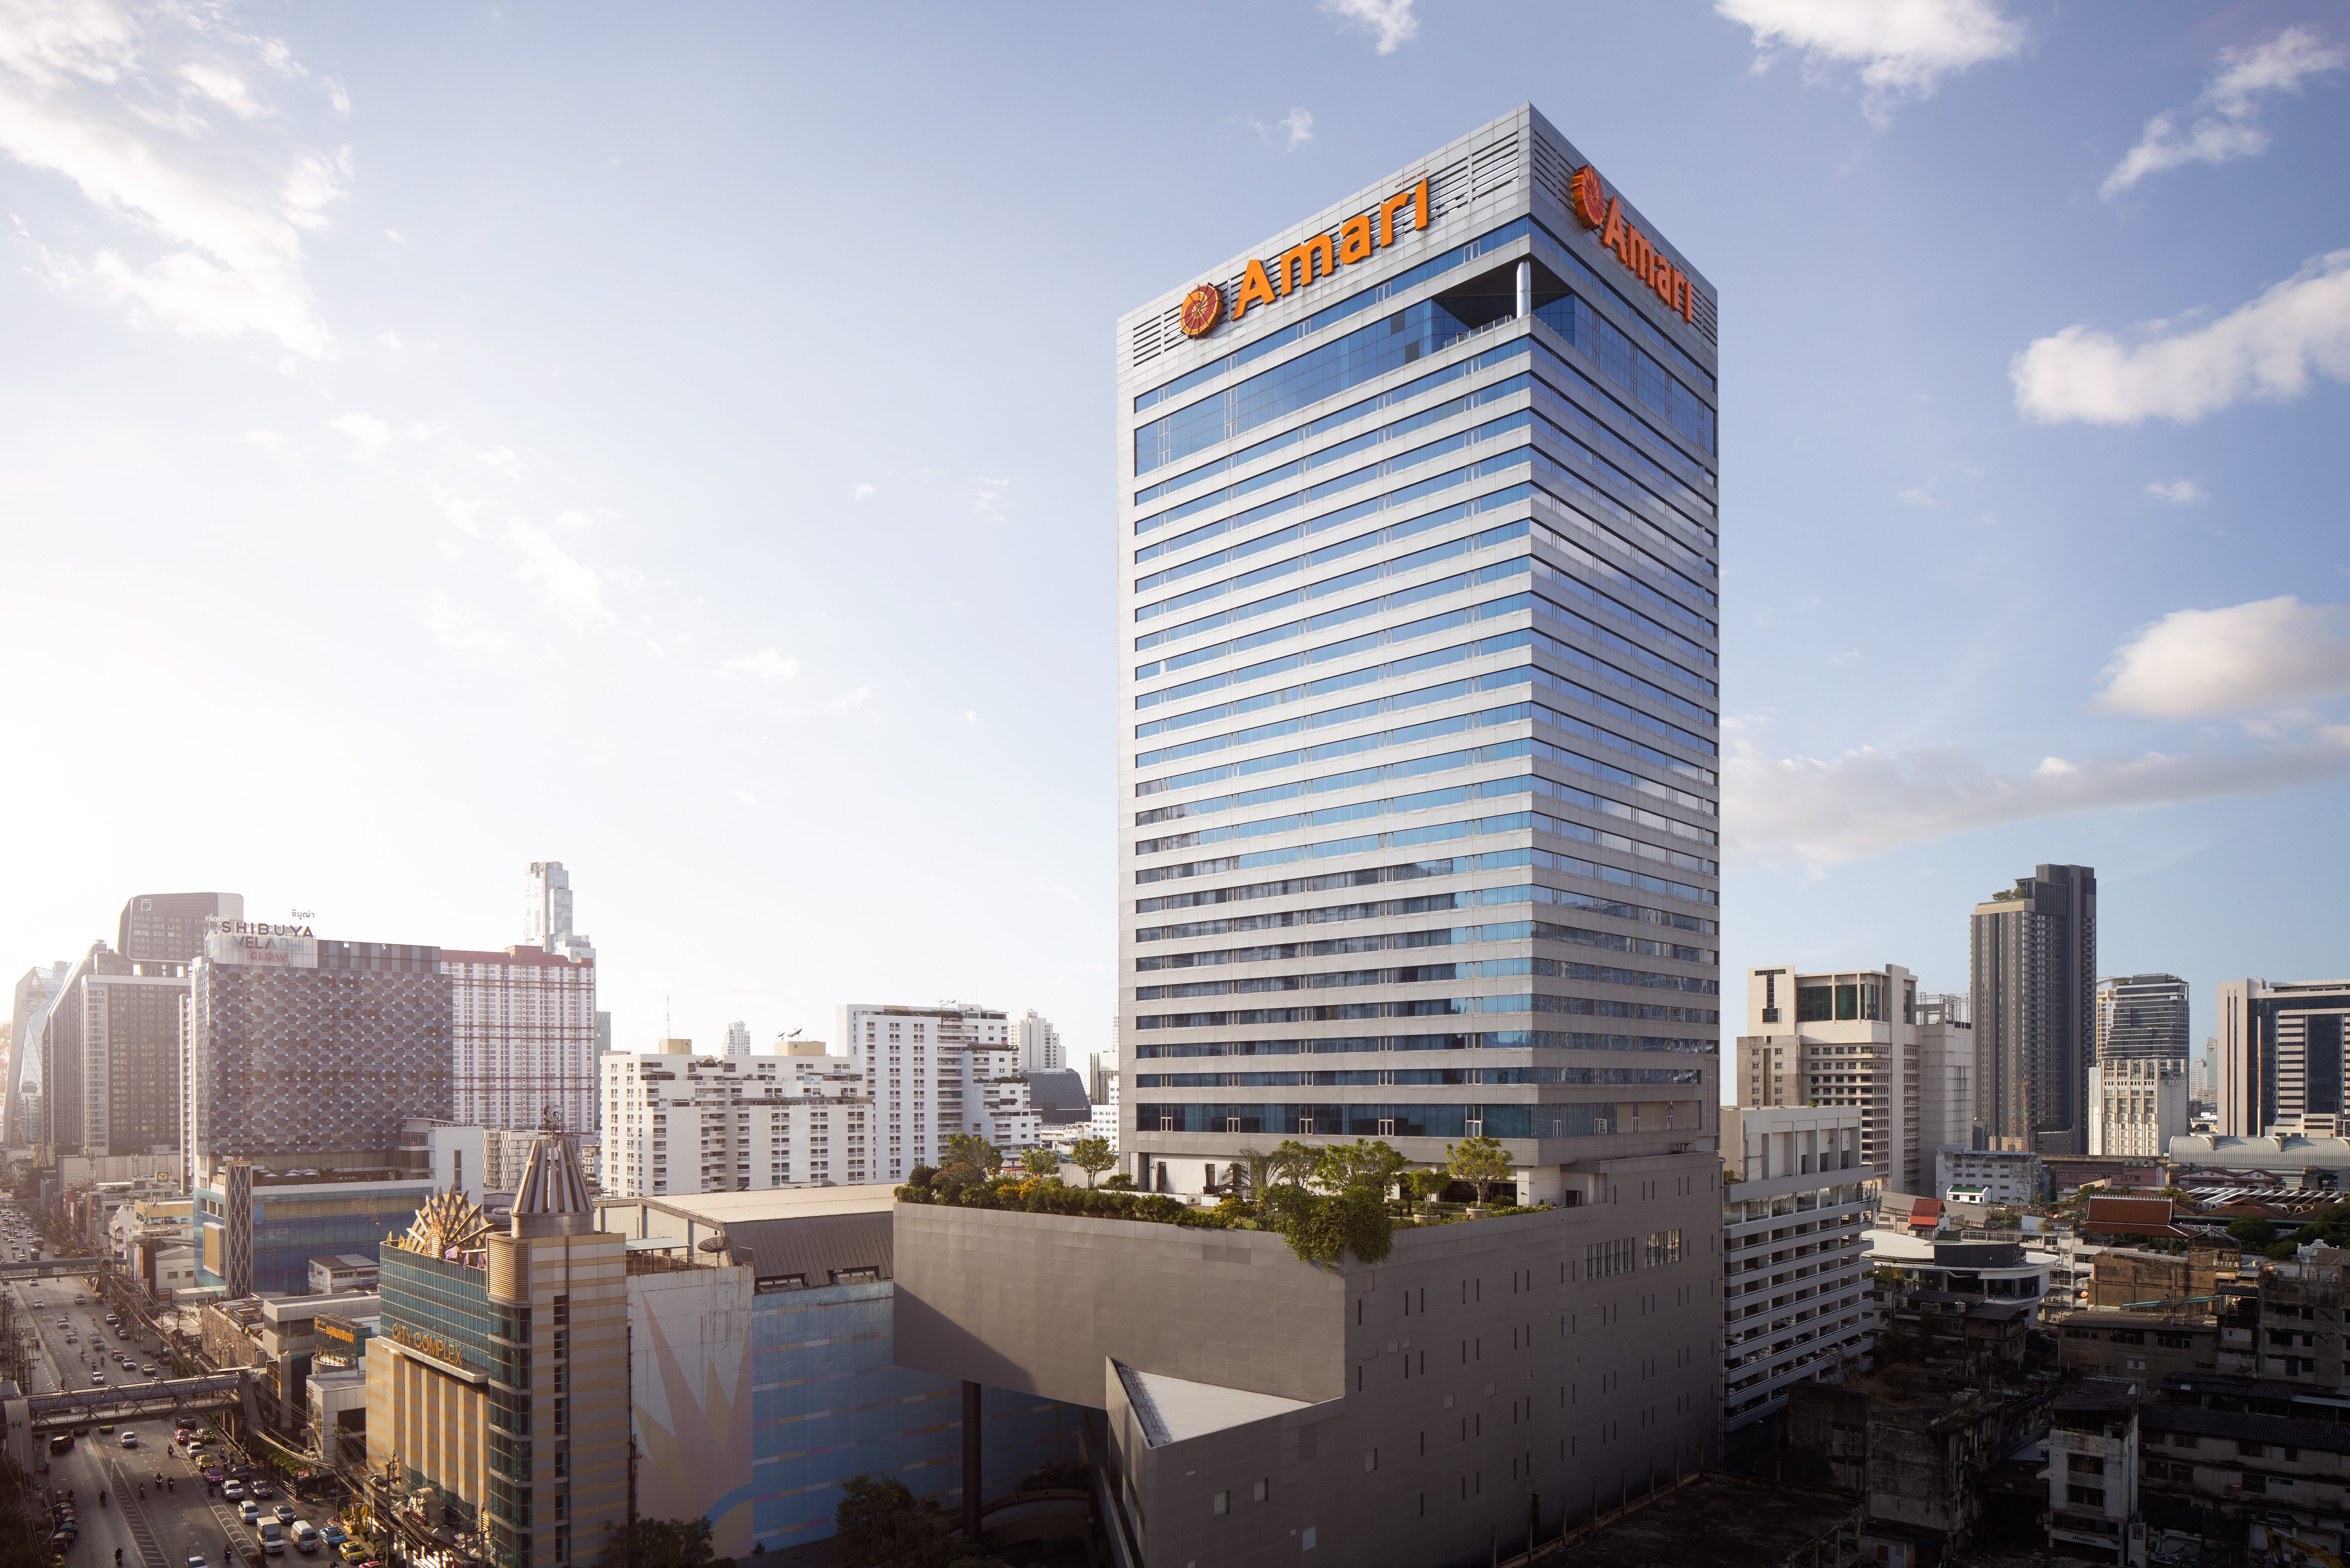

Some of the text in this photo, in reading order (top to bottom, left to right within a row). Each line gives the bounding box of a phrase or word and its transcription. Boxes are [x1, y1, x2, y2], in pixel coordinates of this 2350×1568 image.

[1231, 178, 1428, 321] Amari
[1602, 196, 1692, 323] Amari
[221, 921, 313, 938] SHIBUYA
[250, 951, 288, 960] GLOW
[393, 1323, 463, 1366] CITY COMPLEX
